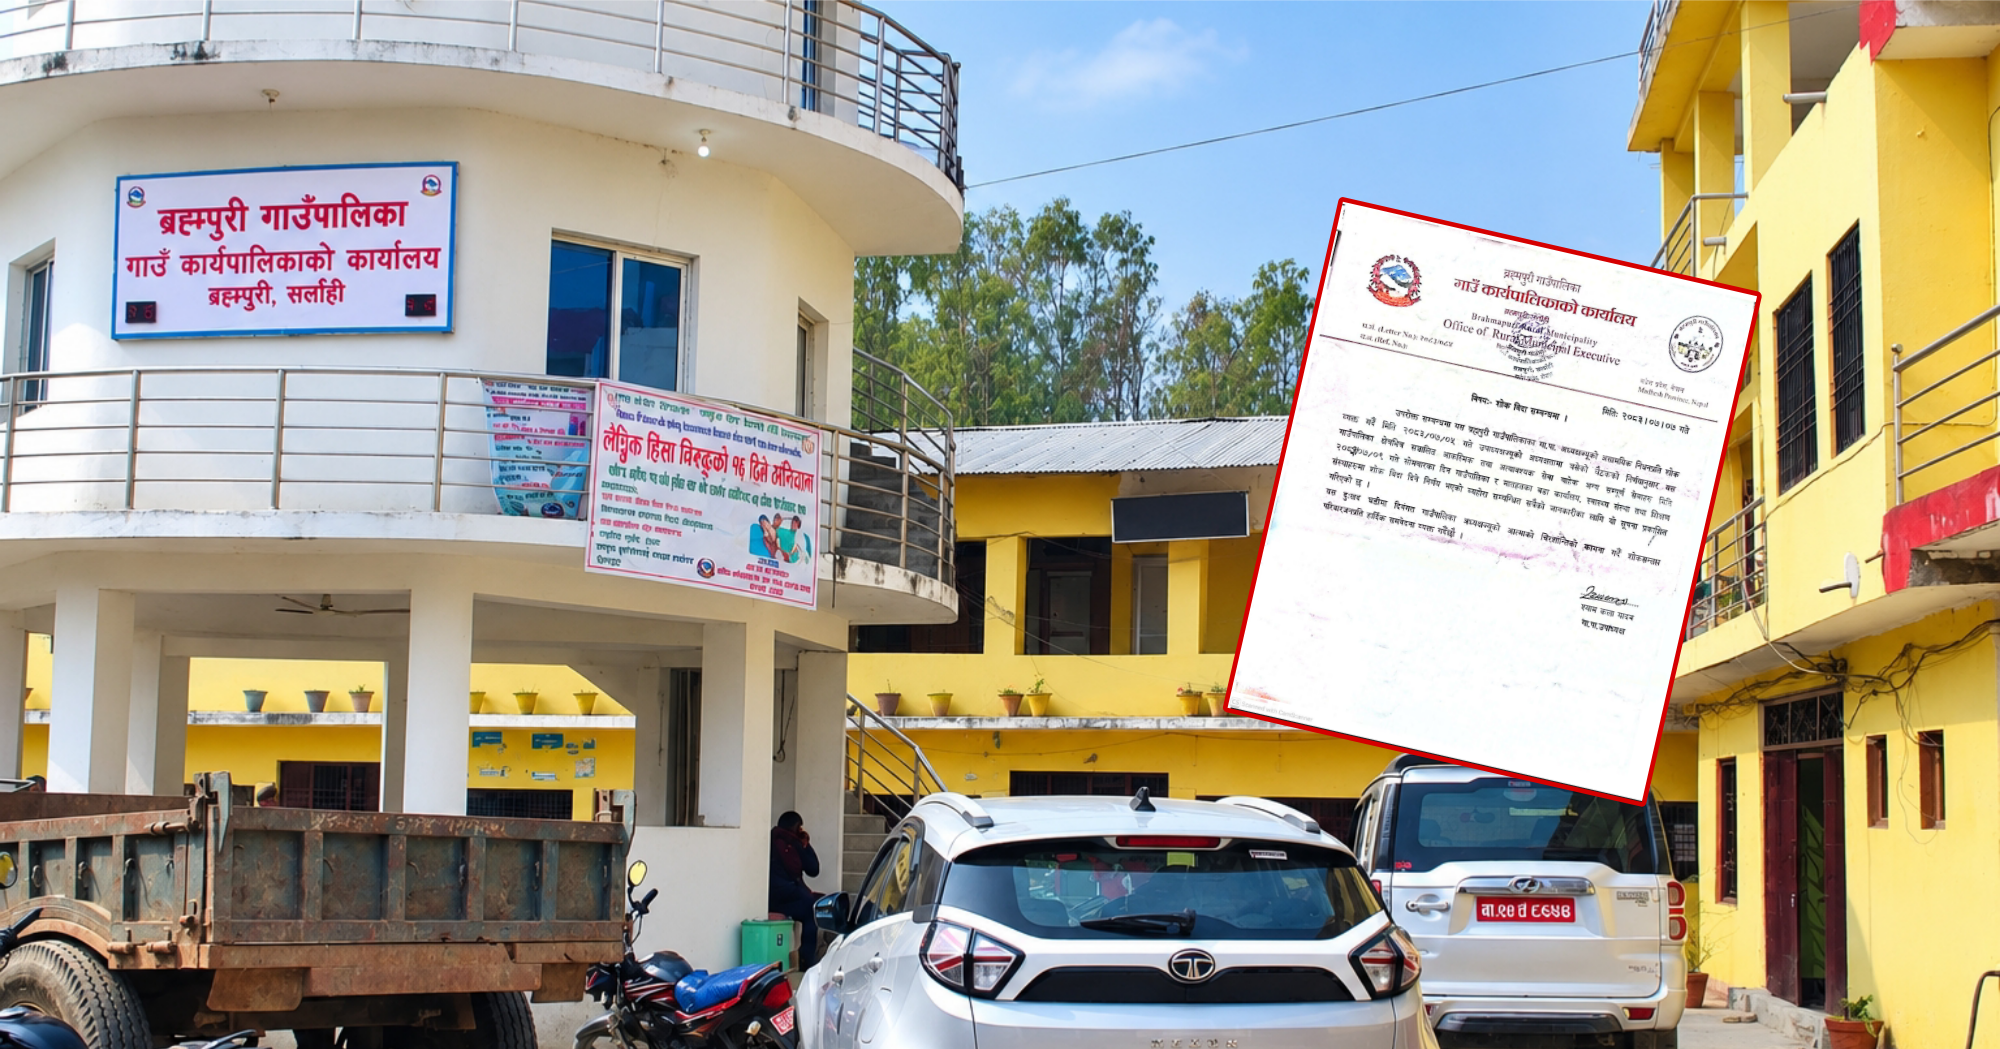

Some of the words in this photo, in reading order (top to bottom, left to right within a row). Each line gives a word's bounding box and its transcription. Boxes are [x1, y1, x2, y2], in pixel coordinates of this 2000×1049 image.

[260, 192, 409, 231] गाउँपालिका
[125, 248, 171, 278] गाउँ
[179, 242, 336, 276] कार्यपालिकाको
[346, 239, 442, 271] कार्यालय
[286, 277, 346, 305] सर्लाही
